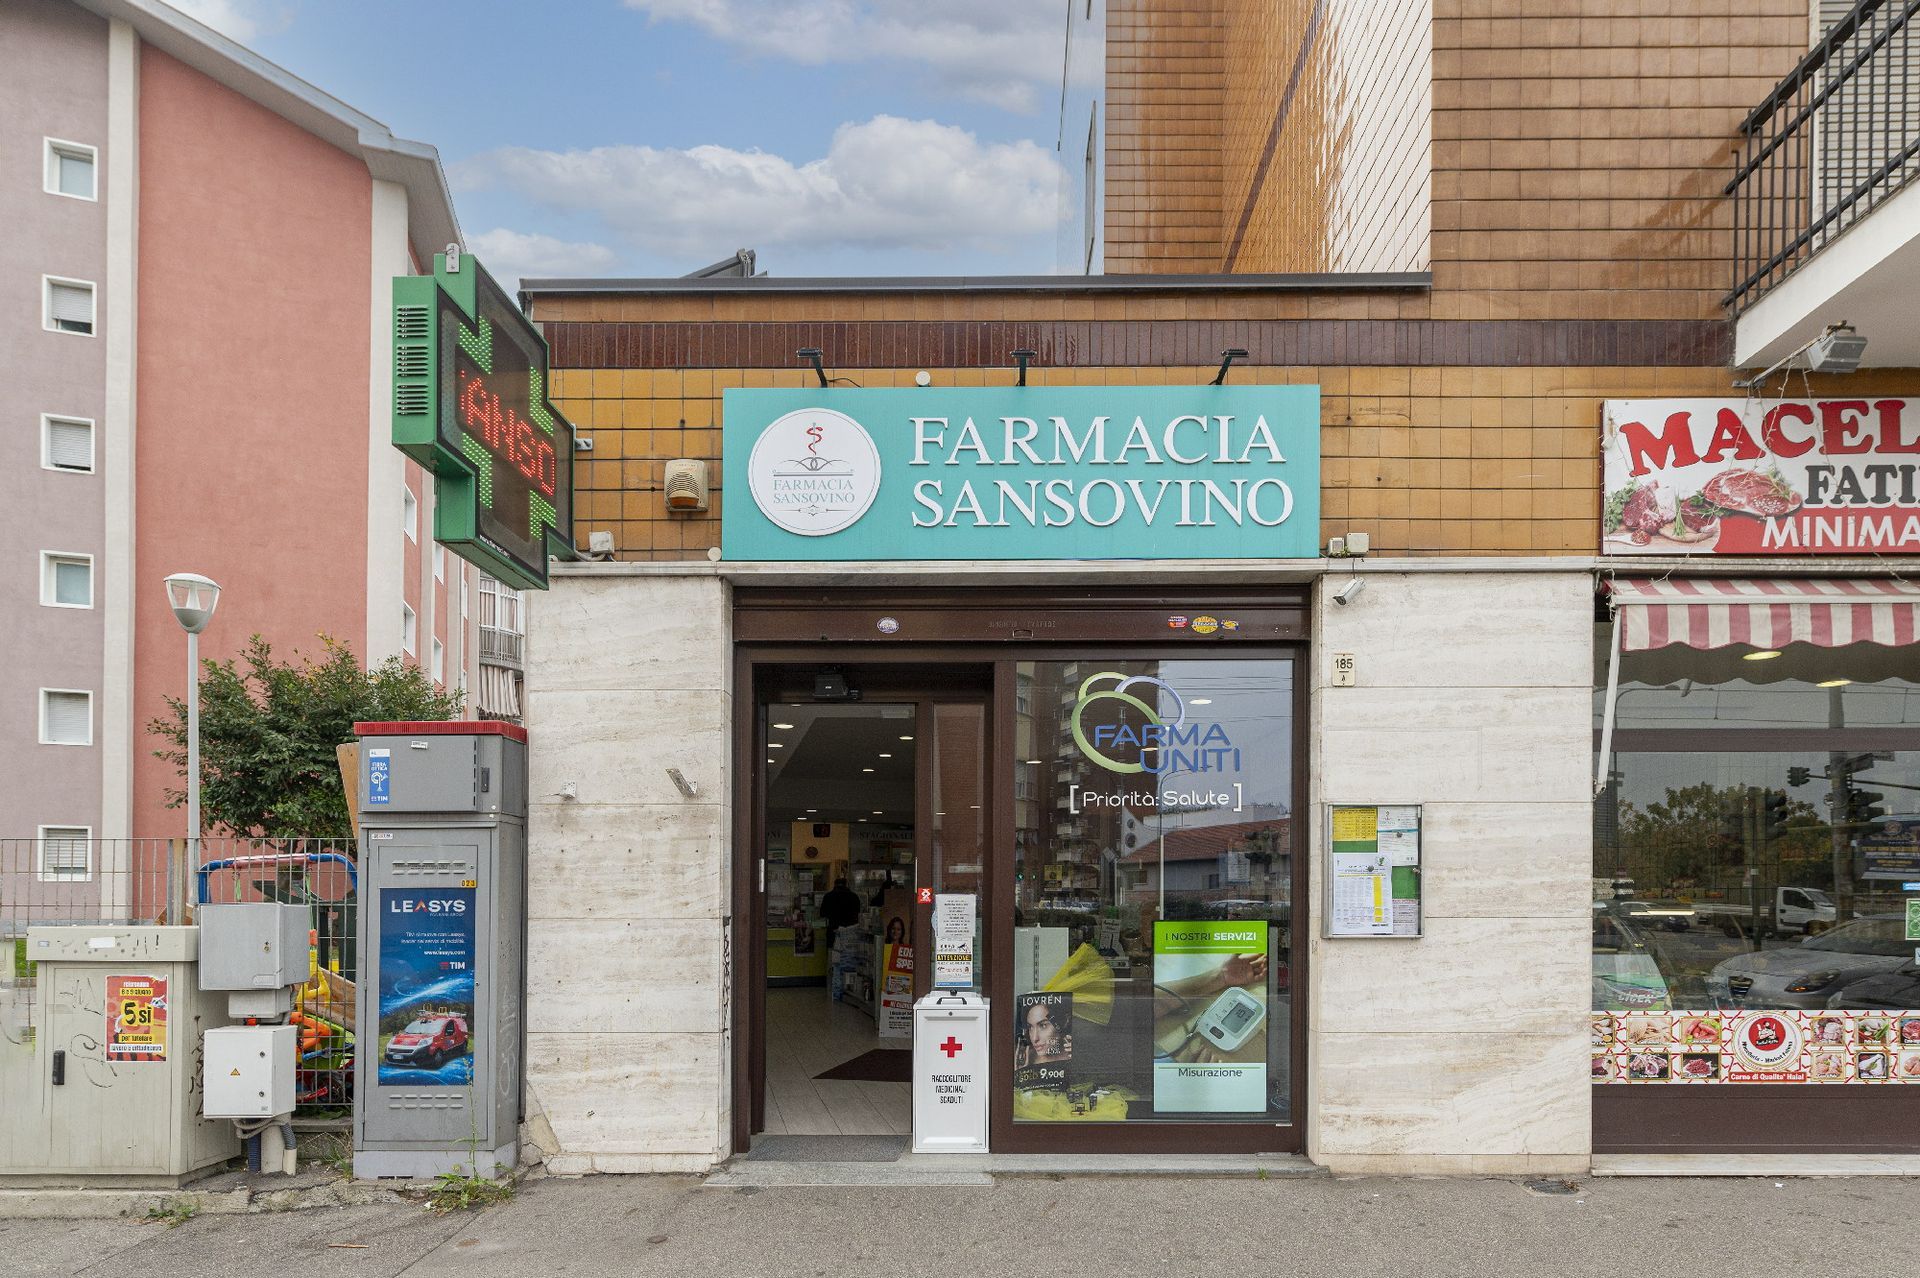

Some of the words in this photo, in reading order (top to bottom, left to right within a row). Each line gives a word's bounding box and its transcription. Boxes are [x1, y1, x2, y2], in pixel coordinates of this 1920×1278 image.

[461, 370, 555, 496] ANSO
[908, 414, 1287, 468] FARMACIA
[773, 479, 854, 491] FARMACIA
[1804, 464, 1920, 505] FATI
[773, 492, 855, 504] SANSOVINO
[911, 477, 1294, 529] SANSOVINO
[1335, 658, 1353, 669] 185
[1094, 723, 1231, 747] FARMA
[1140, 747, 1240, 774] UNITI
[1163, 789, 1230, 806] Salute
[391, 899, 466, 913] LEASYS
[1171, 933, 1211, 941] NOSTRI
[1213, 933, 1257, 941] SERVIZI
[449, 961, 466, 969] TIM
[124, 1002, 136, 1024] 5
[931, 1074, 972, 1083] RACCOGLITORE
[1178, 1067, 1243, 1078] Misurazione
